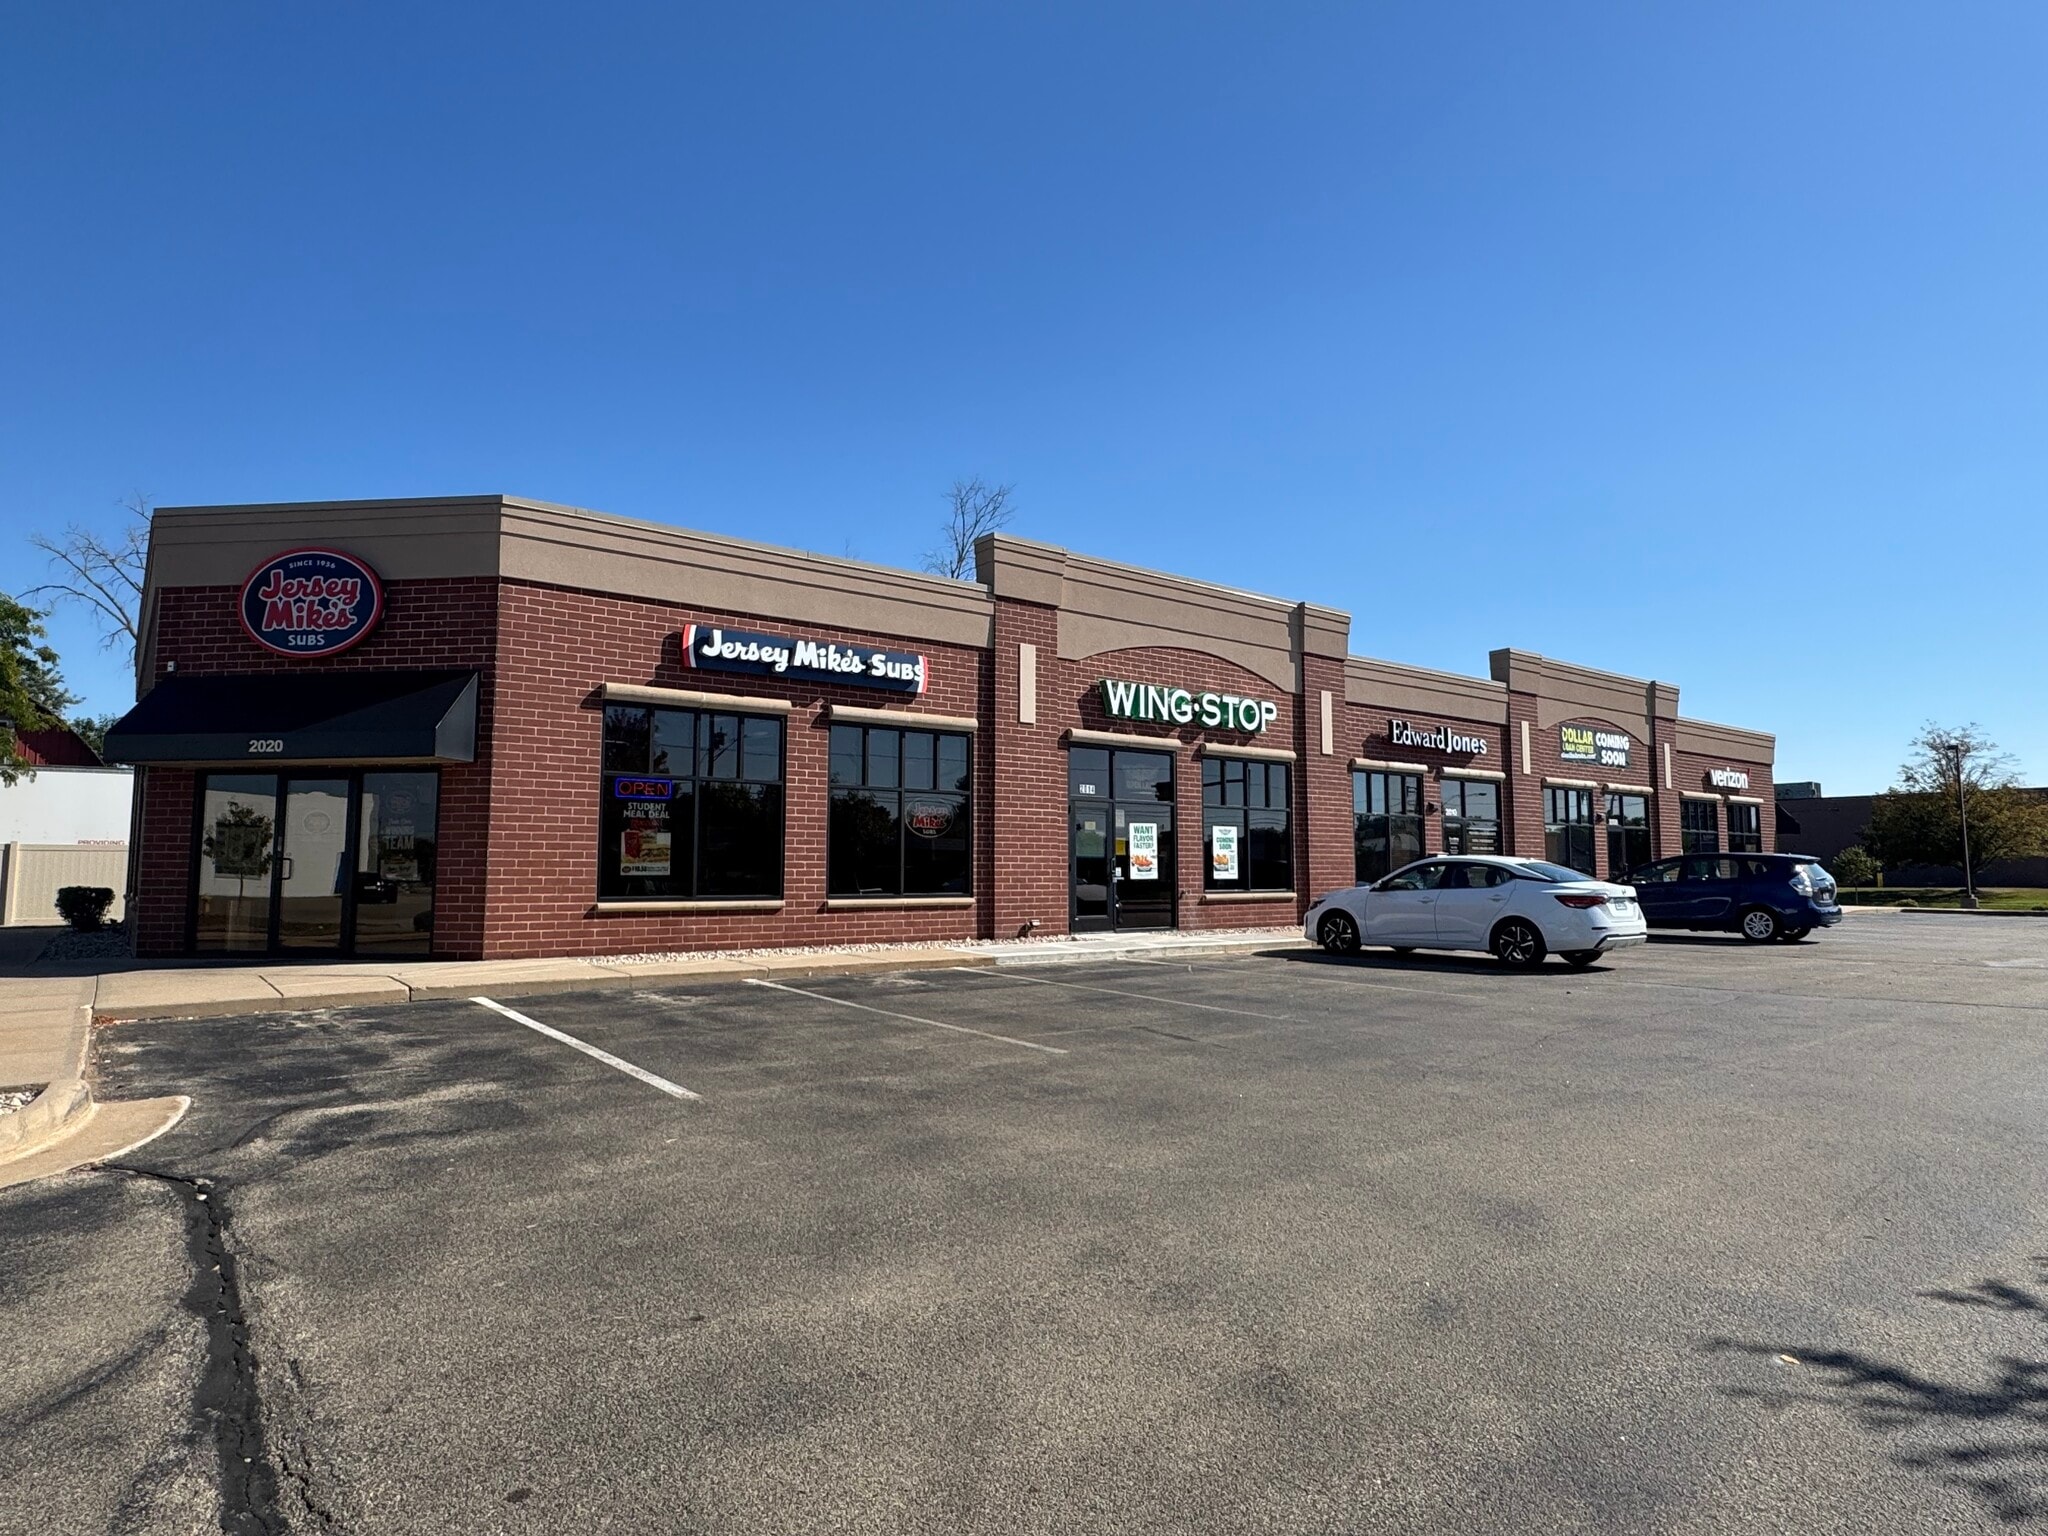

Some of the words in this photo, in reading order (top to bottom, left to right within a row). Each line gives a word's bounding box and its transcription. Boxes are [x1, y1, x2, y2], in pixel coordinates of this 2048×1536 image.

[289, 560, 313, 569] SINCE
[258, 569, 360, 607] Jersey
[262, 599, 357, 631] Mike's
[288, 634, 325, 646] SUBS
[702, 629, 789, 672] Jersey
[793, 640, 866, 674] Mike's
[1392, 719, 1445, 750] Edward
[1446, 727, 1488, 755] Jones
[1561, 727, 1593, 745] DOLLAR
[1595, 732, 1629, 750] COMING
[248, 739, 284, 753] 2020
[1600, 750, 1626, 766] SOON
[1710, 766, 1749, 789] verizon
[619, 781, 668, 795] OPEN
[623, 809, 646, 818] MEAL
[648, 810, 670, 819] DEAL
[627, 801, 666, 811] STUDENT
[1133, 825, 1154, 835] WANT
[1133, 834, 1154, 842] FLAVOR
[383, 834, 414, 850] TEAM
